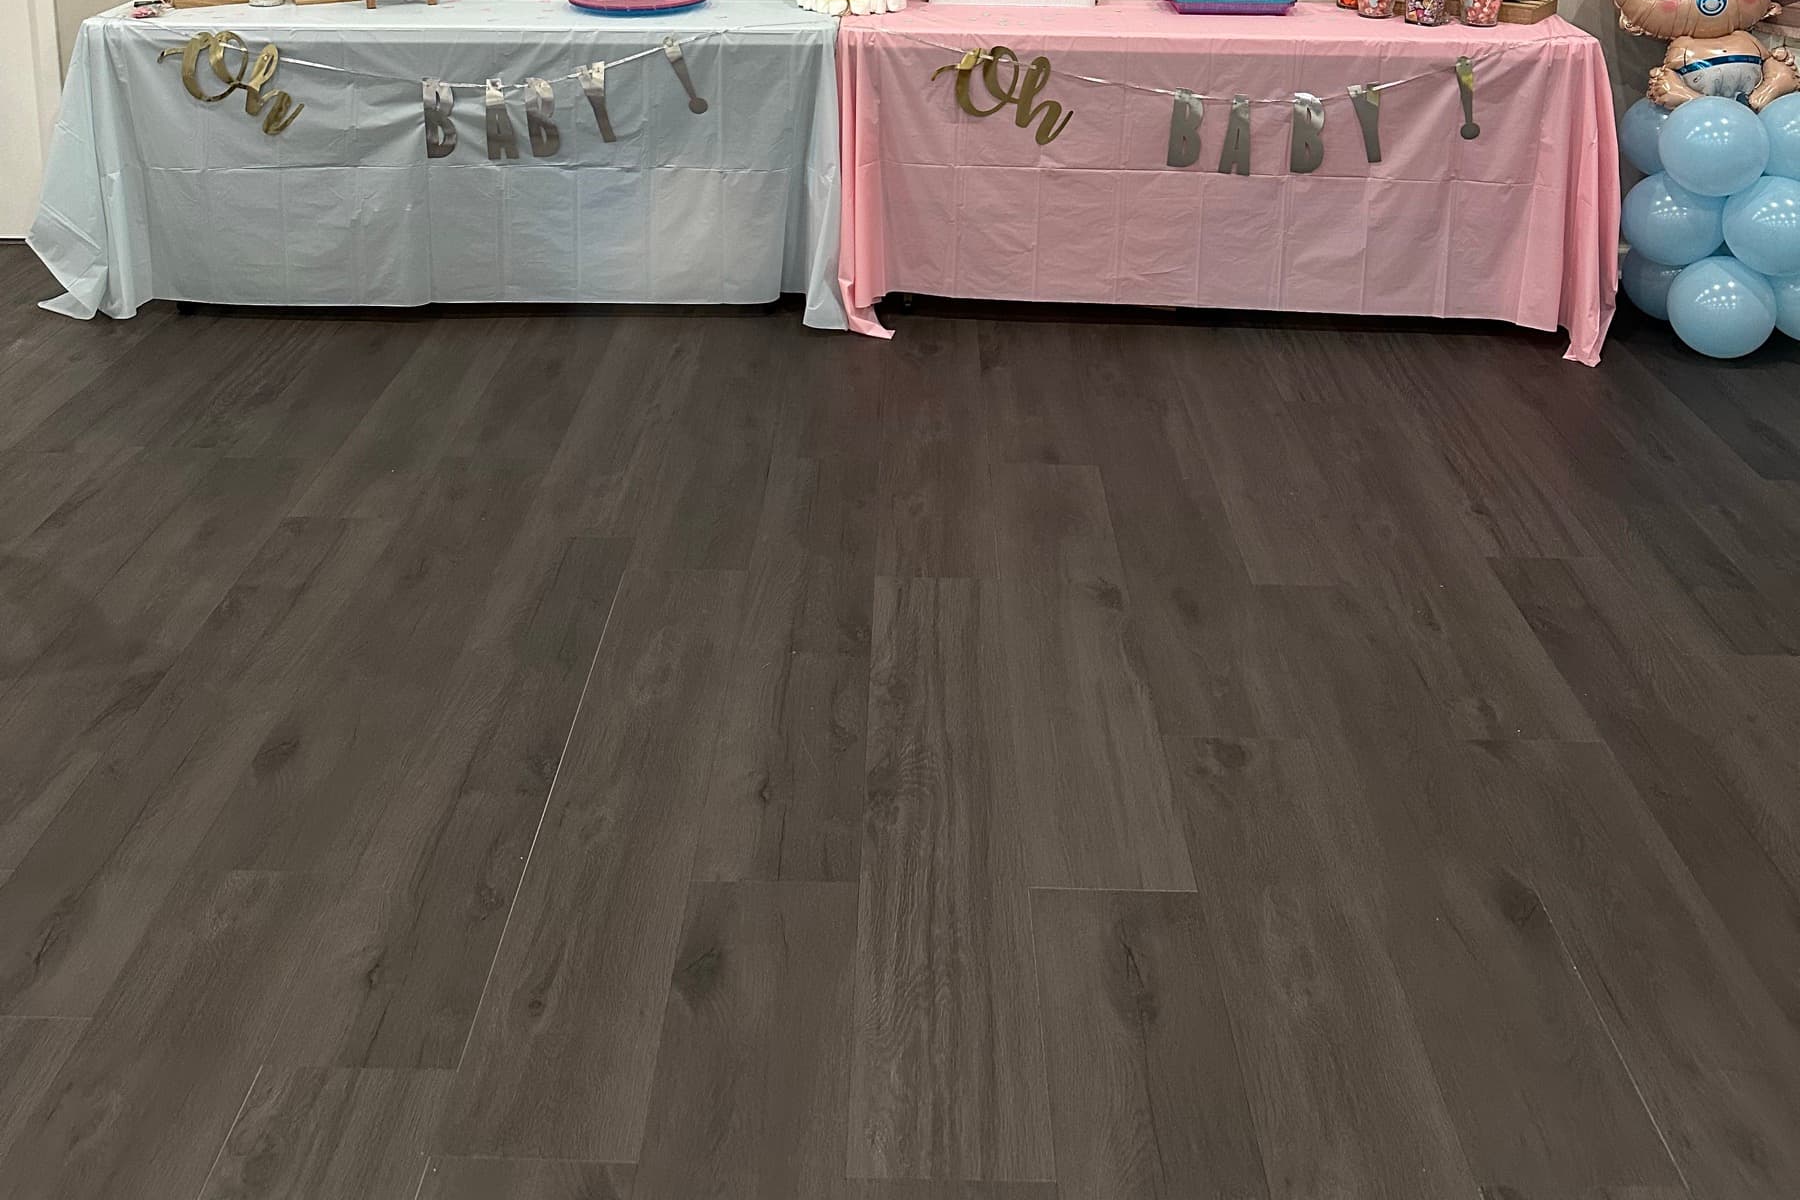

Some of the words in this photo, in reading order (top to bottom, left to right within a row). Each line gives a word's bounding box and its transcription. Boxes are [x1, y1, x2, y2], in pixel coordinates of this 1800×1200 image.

[157, 31, 304, 135] Oh
[422, 61, 617, 160] BABY
[932, 45, 1074, 146] Oh
[1166, 80, 1383, 176] BABY
